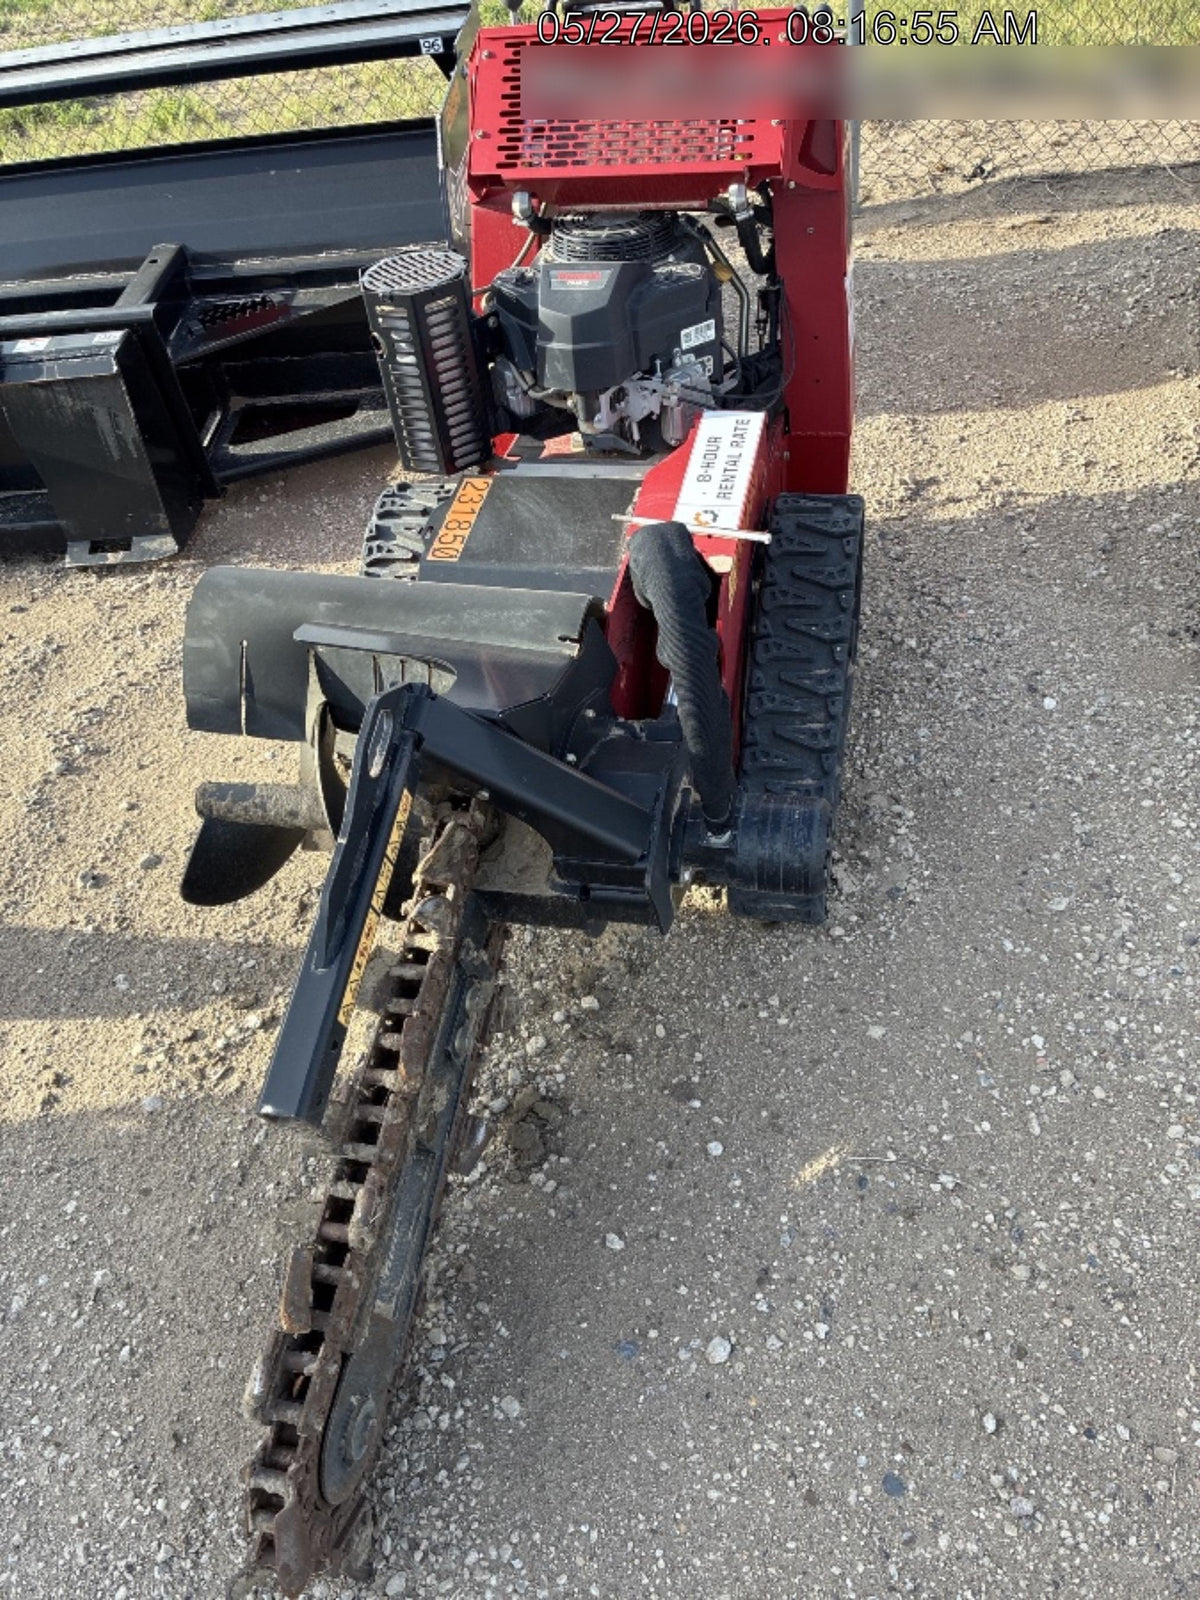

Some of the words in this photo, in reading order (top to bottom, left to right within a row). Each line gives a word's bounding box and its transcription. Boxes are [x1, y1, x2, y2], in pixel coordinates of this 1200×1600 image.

[423, 39, 441, 52] 96
[696, 436, 722, 482] 8-HOUR
[716, 453, 742, 500] RENTAL
[730, 419, 751, 449] RATE
[431, 481, 490, 558] 231850
